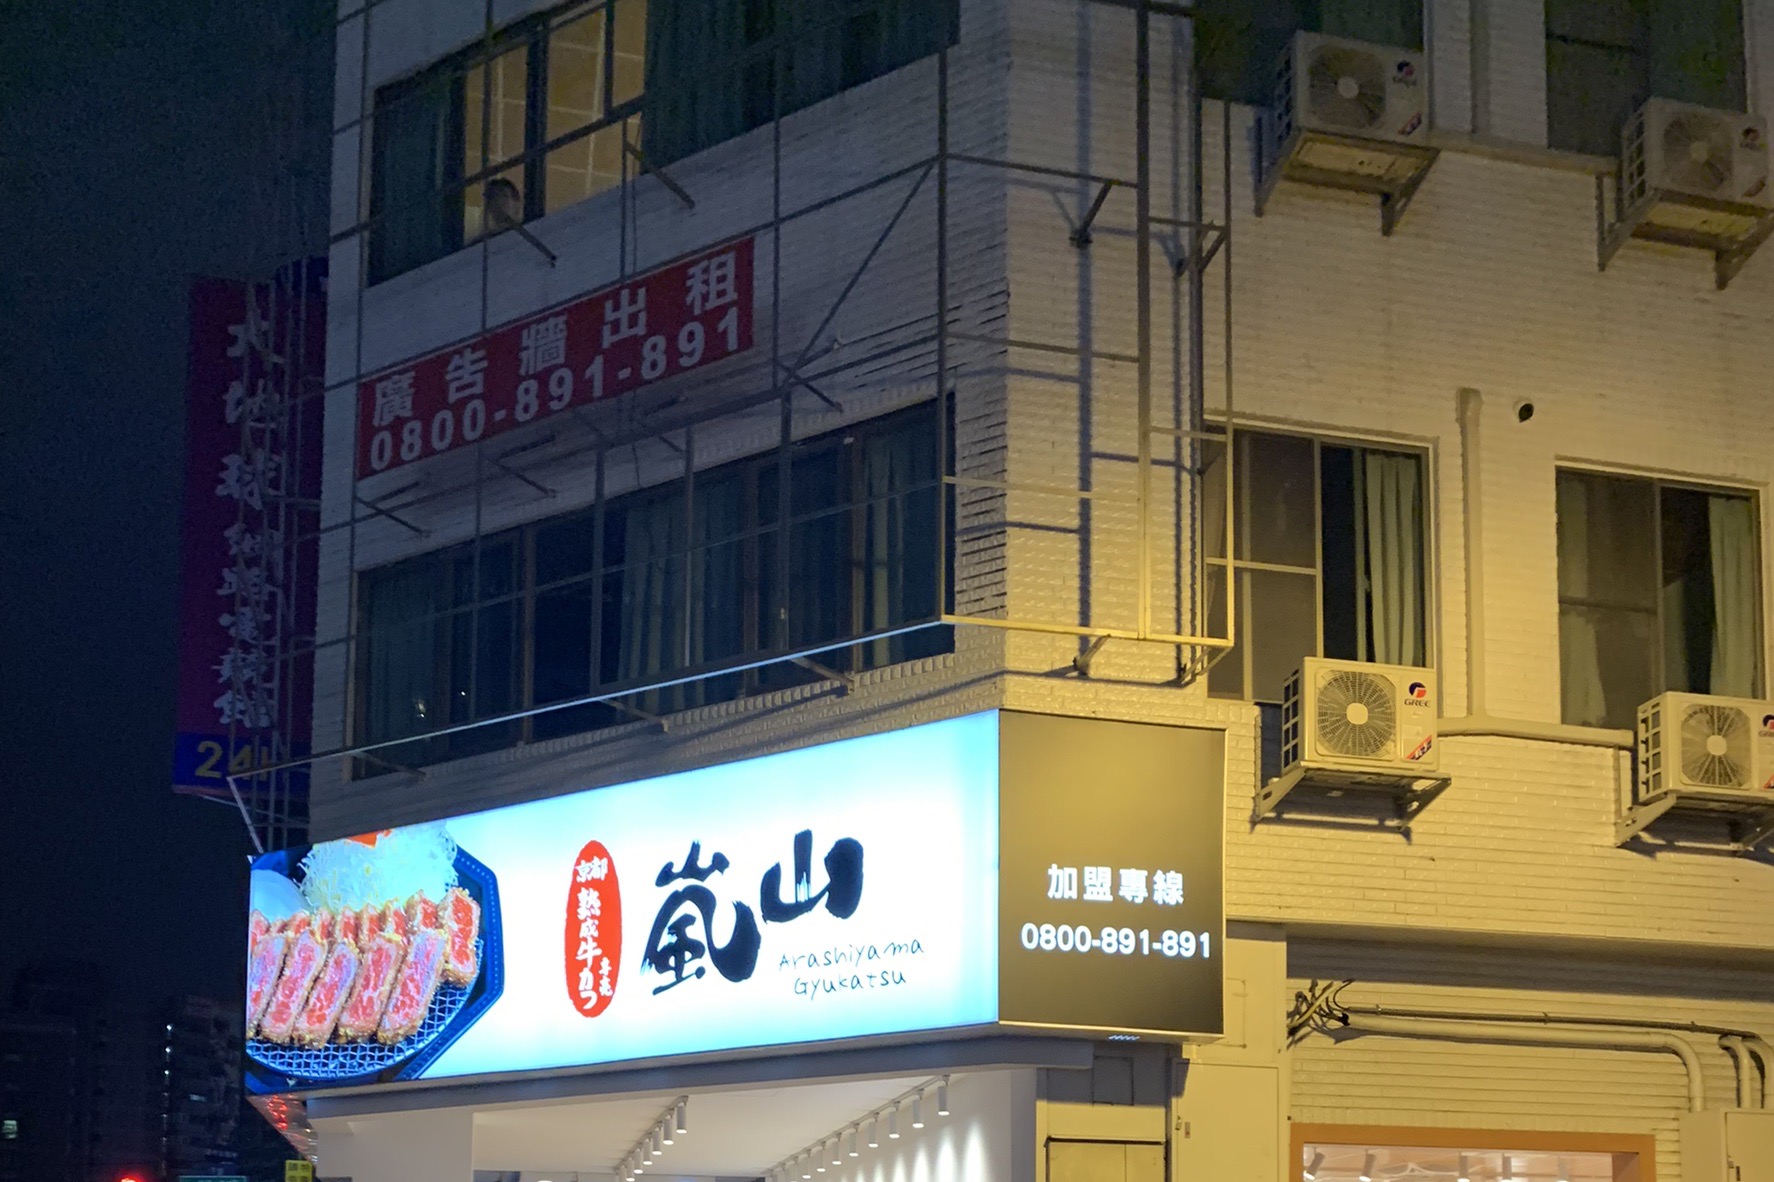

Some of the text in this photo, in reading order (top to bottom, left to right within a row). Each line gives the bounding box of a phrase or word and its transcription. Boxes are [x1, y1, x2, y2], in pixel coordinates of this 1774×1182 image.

[371, 251, 739, 427] 廣告牆出租
[369, 306, 742, 473] 0800-891-891
[575, 856, 610, 883] 京都
[1046, 863, 1185, 907] 加盟專線
[640, 827, 865, 996] 嵐山
[1020, 922, 1211, 960] 0800-891-891
[792, 967, 909, 997] Gyukatsu
